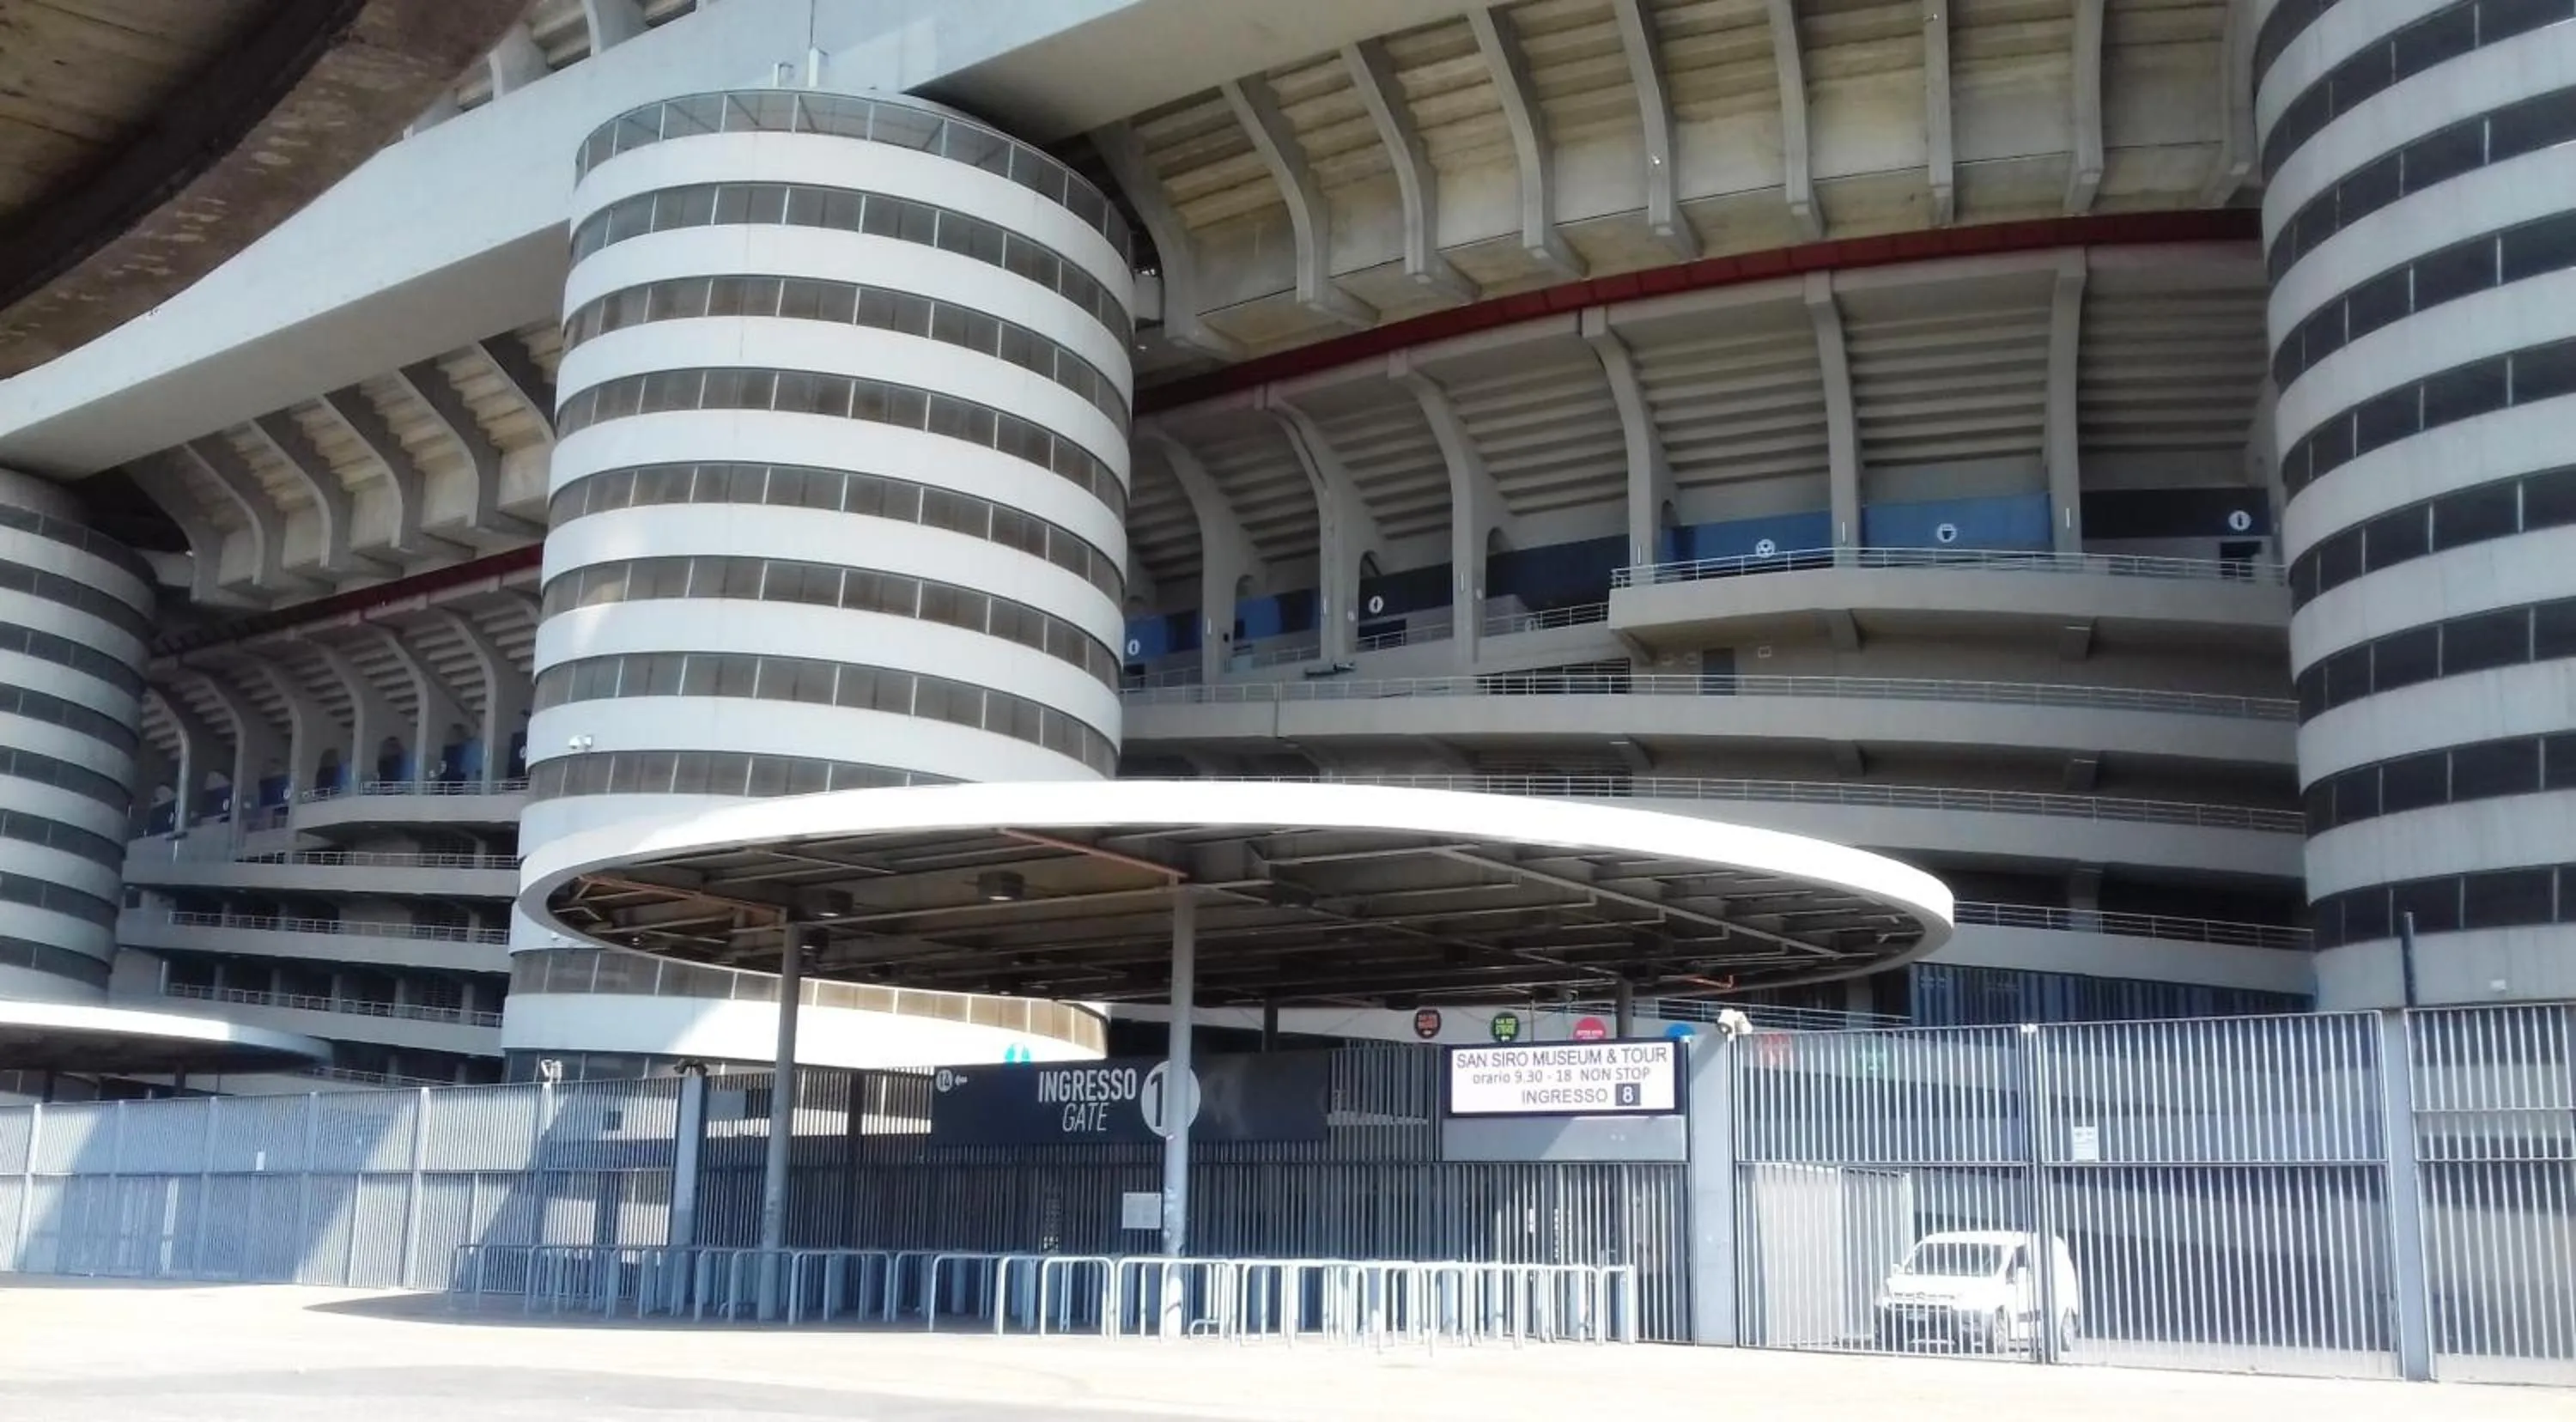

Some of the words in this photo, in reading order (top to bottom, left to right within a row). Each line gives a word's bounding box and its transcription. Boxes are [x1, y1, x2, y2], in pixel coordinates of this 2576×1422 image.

[1457, 1053, 1487, 1068] SAN
[1492, 1051, 1528, 1067] SIRO
[1534, 1048, 1601, 1066] MUSEUM
[1607, 1048, 1617, 1064] &
[1621, 1047, 1668, 1064] TOUR
[1038, 1067, 1136, 1103] INGRESSO
[1473, 1073, 1510, 1084] orario
[1514, 1070, 1543, 1083] 9.30
[1557, 1069, 1572, 1082] 18
[1581, 1067, 1612, 1082] NON
[1616, 1066, 1649, 1080] STOP
[1522, 1088, 1608, 1104] INGRESSO
[1622, 1085, 1634, 1103] 8
[1062, 1103, 1109, 1132] GATE
